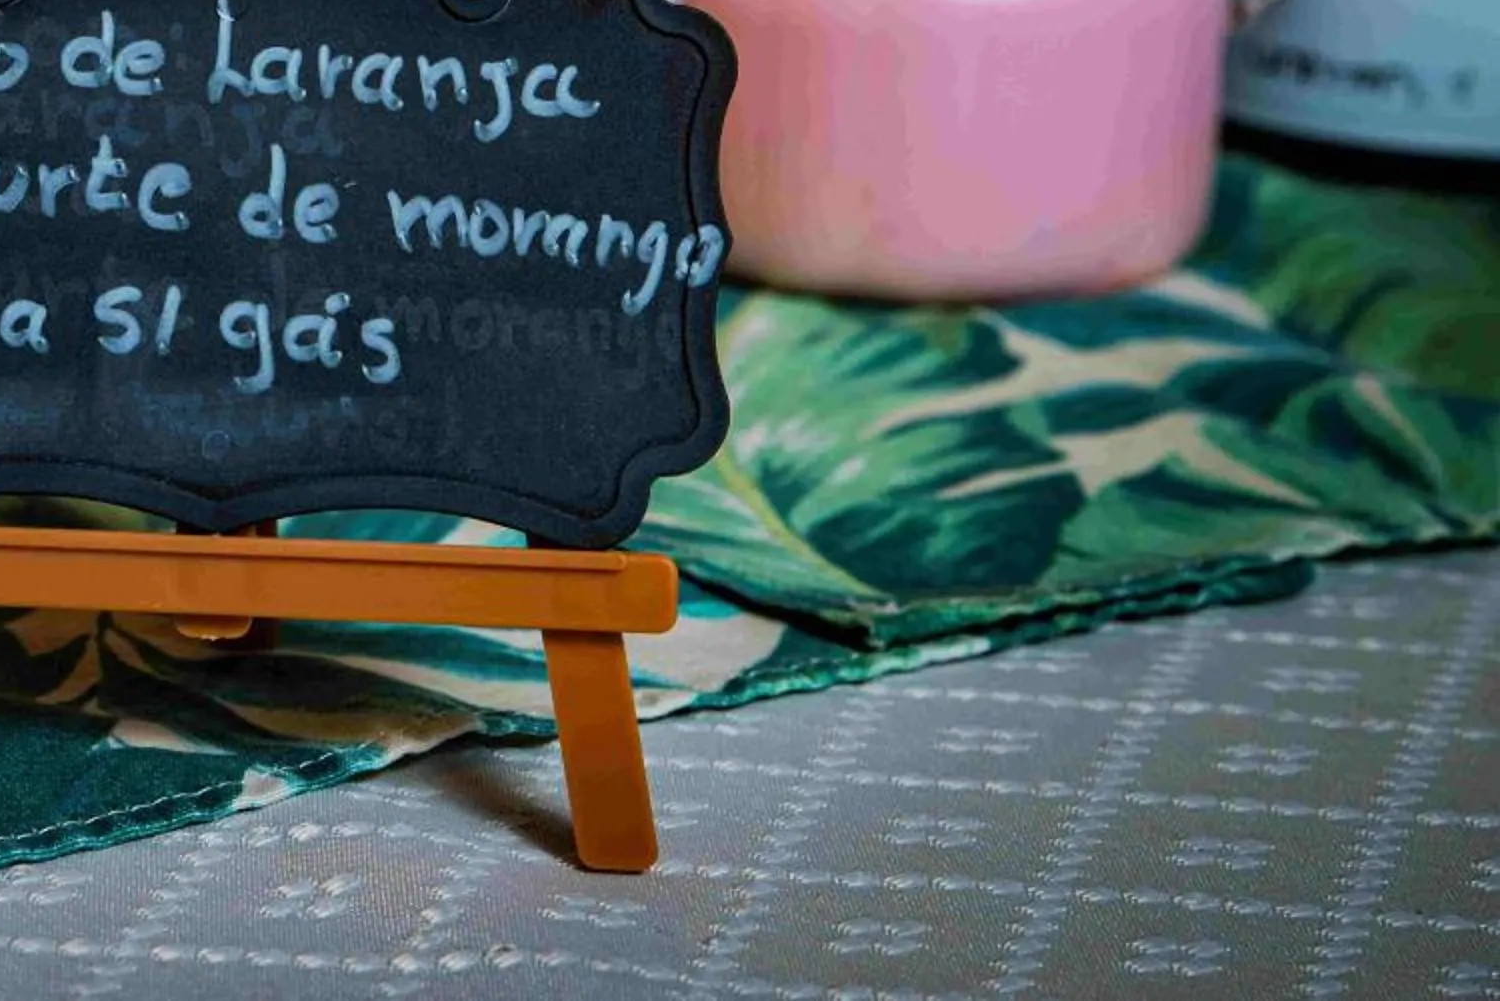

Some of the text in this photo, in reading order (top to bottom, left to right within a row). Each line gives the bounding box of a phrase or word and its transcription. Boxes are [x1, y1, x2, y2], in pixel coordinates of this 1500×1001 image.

[60, 9, 165, 95] de
[238, 143, 341, 243] de
[388, 190, 725, 316] morango
[218, 292, 400, 393] gás
